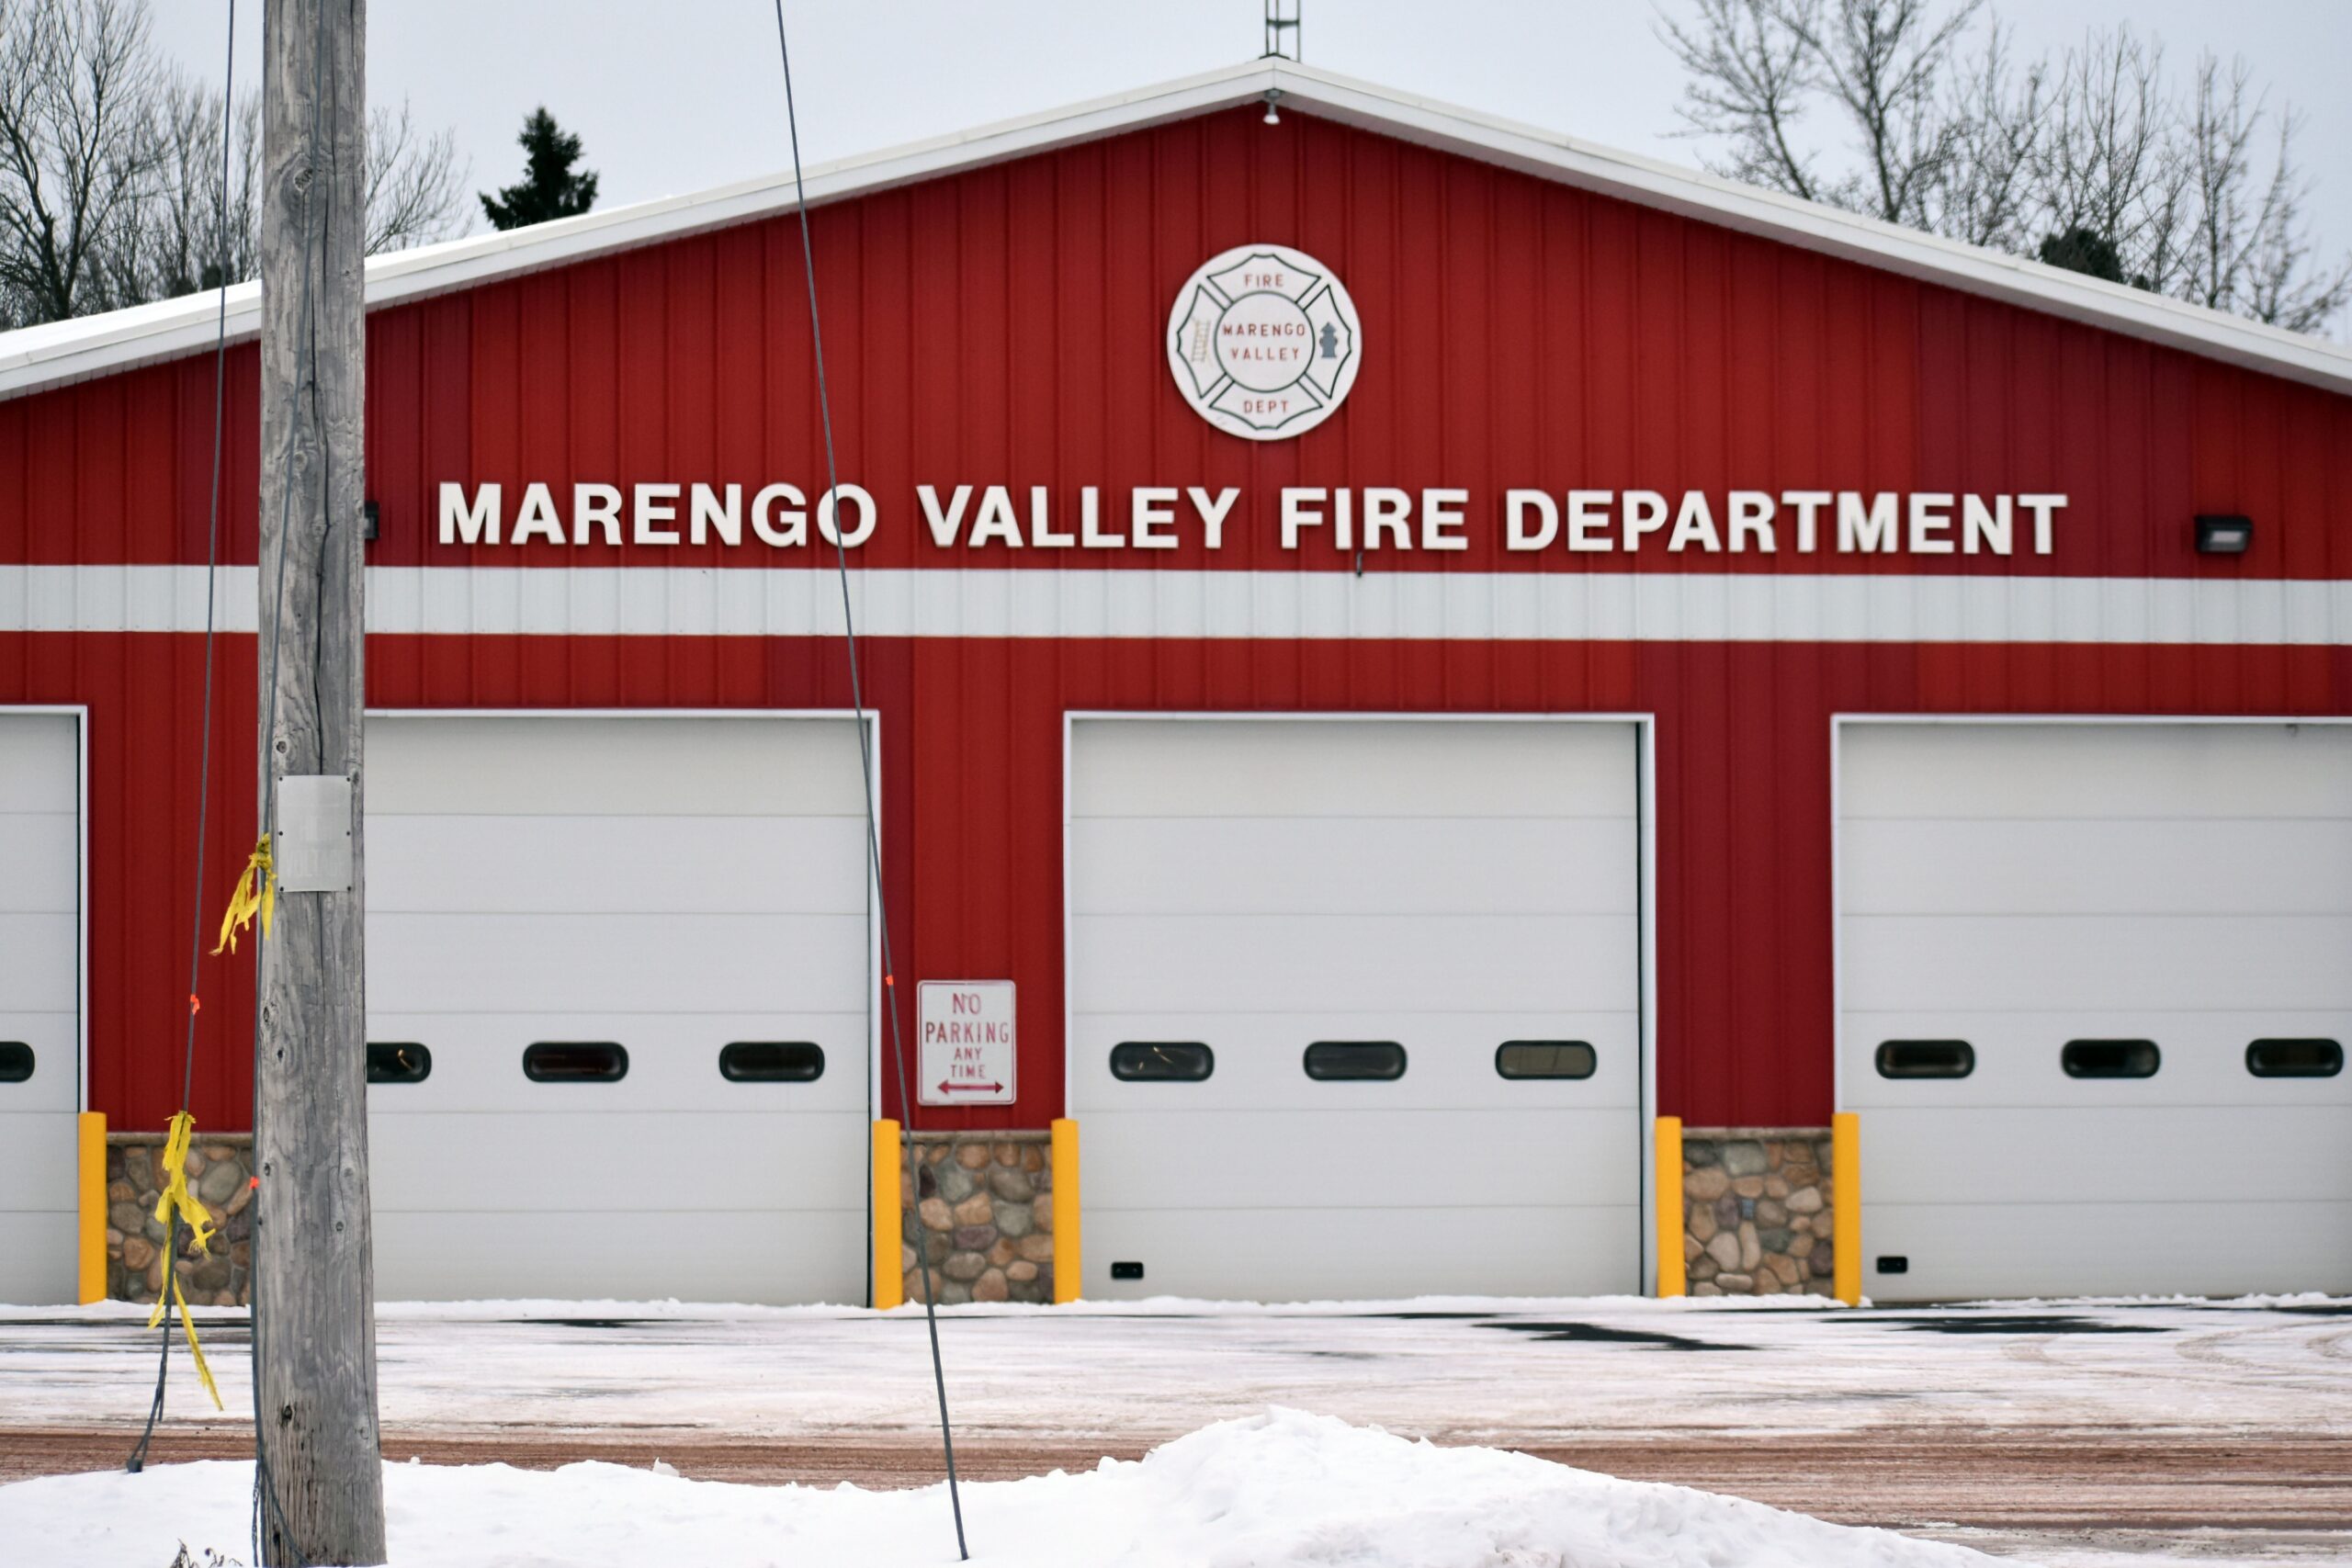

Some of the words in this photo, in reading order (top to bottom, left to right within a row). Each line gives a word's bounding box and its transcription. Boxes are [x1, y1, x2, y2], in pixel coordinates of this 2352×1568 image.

[1244, 275, 1284, 288] FIRE
[1223, 323, 1306, 337] MARENGO
[1231, 348, 1300, 361] VALLEY
[1244, 400, 1290, 413] DEPT
[438, 482, 876, 548] MARENGO
[916, 485, 1240, 549] VALLEY
[1280, 487, 1469, 550] FIRE
[1505, 489, 2068, 555] DEPARTMENT
[953, 993, 981, 1014] NO
[925, 1022, 1009, 1043] PARKING
[954, 1047, 982, 1061] ANY
[951, 1065, 986, 1078] TIME
